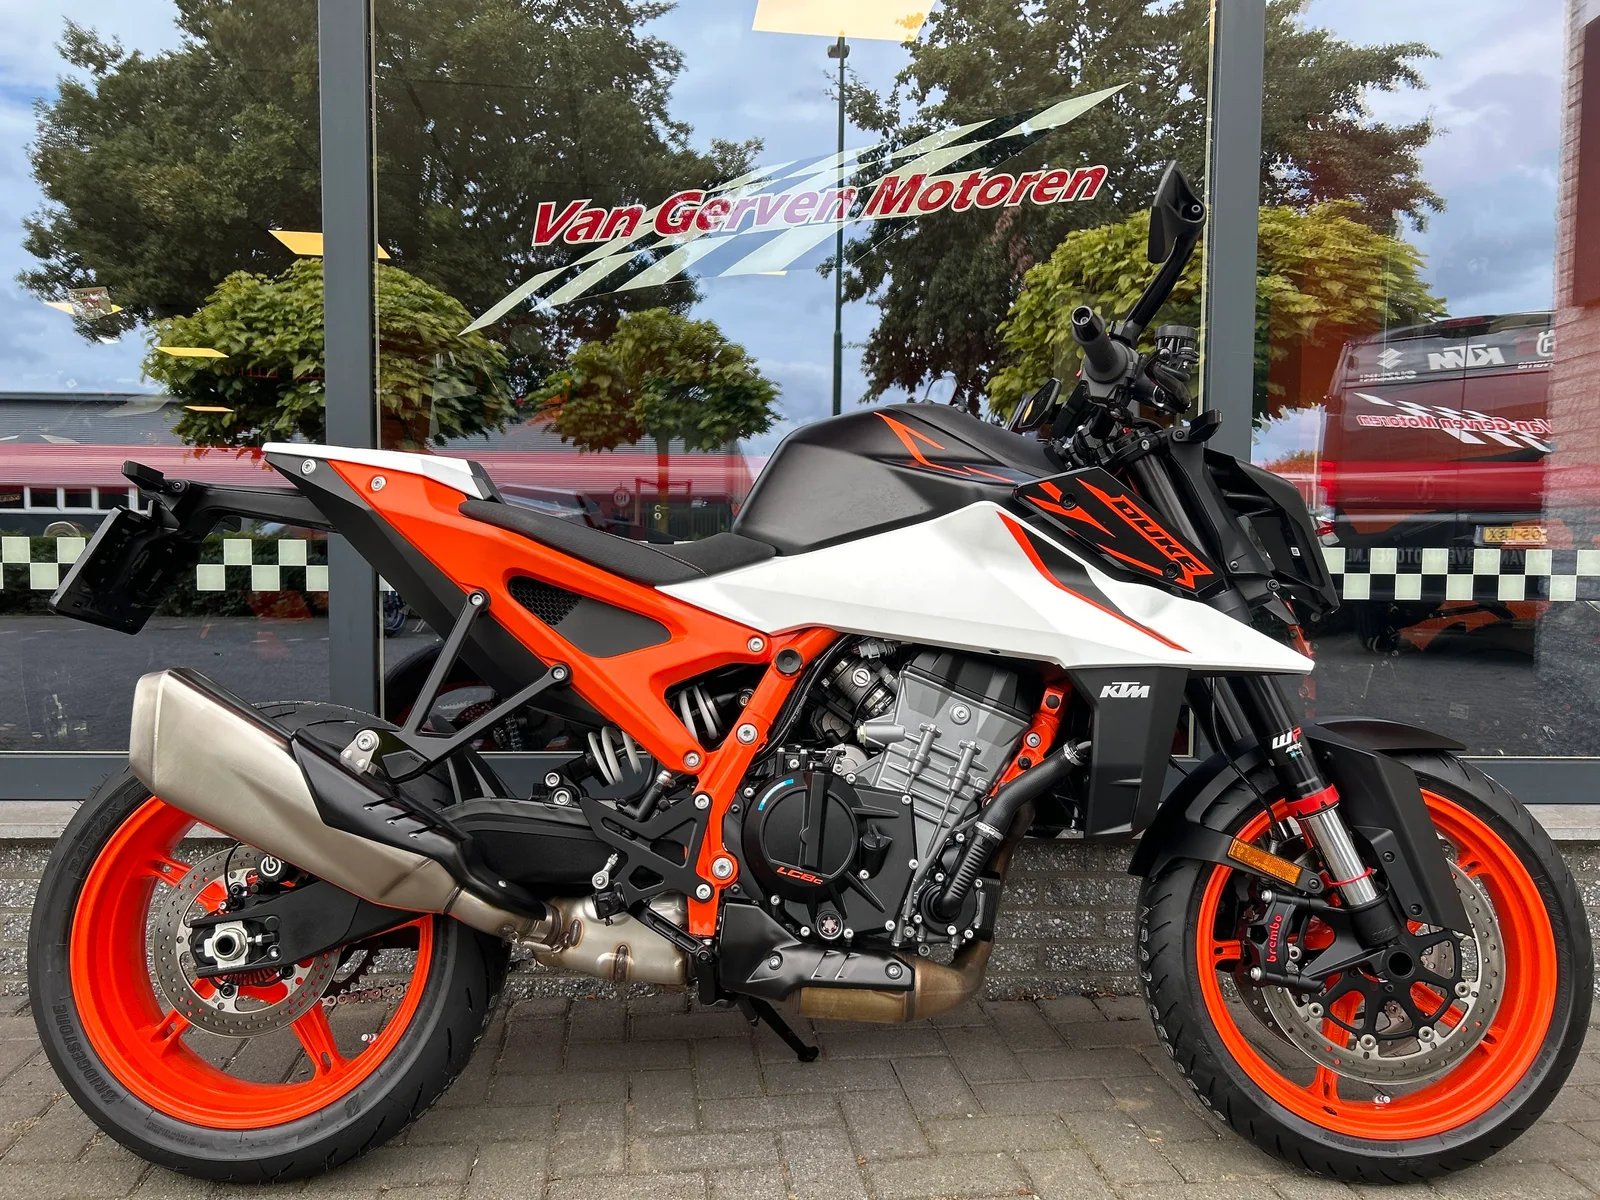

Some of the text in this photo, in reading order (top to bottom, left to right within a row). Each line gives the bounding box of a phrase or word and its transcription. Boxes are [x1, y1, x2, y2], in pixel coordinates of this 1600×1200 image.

[532, 165, 1108, 246] Van Gerven Motoren
[1110, 497, 1208, 575] DUKE
[1100, 681, 1151, 698] KTM
[1272, 727, 1302, 749] WP
[1267, 915, 1282, 962] brembo
[52, 1004, 121, 1105] BRIDGESTONE
